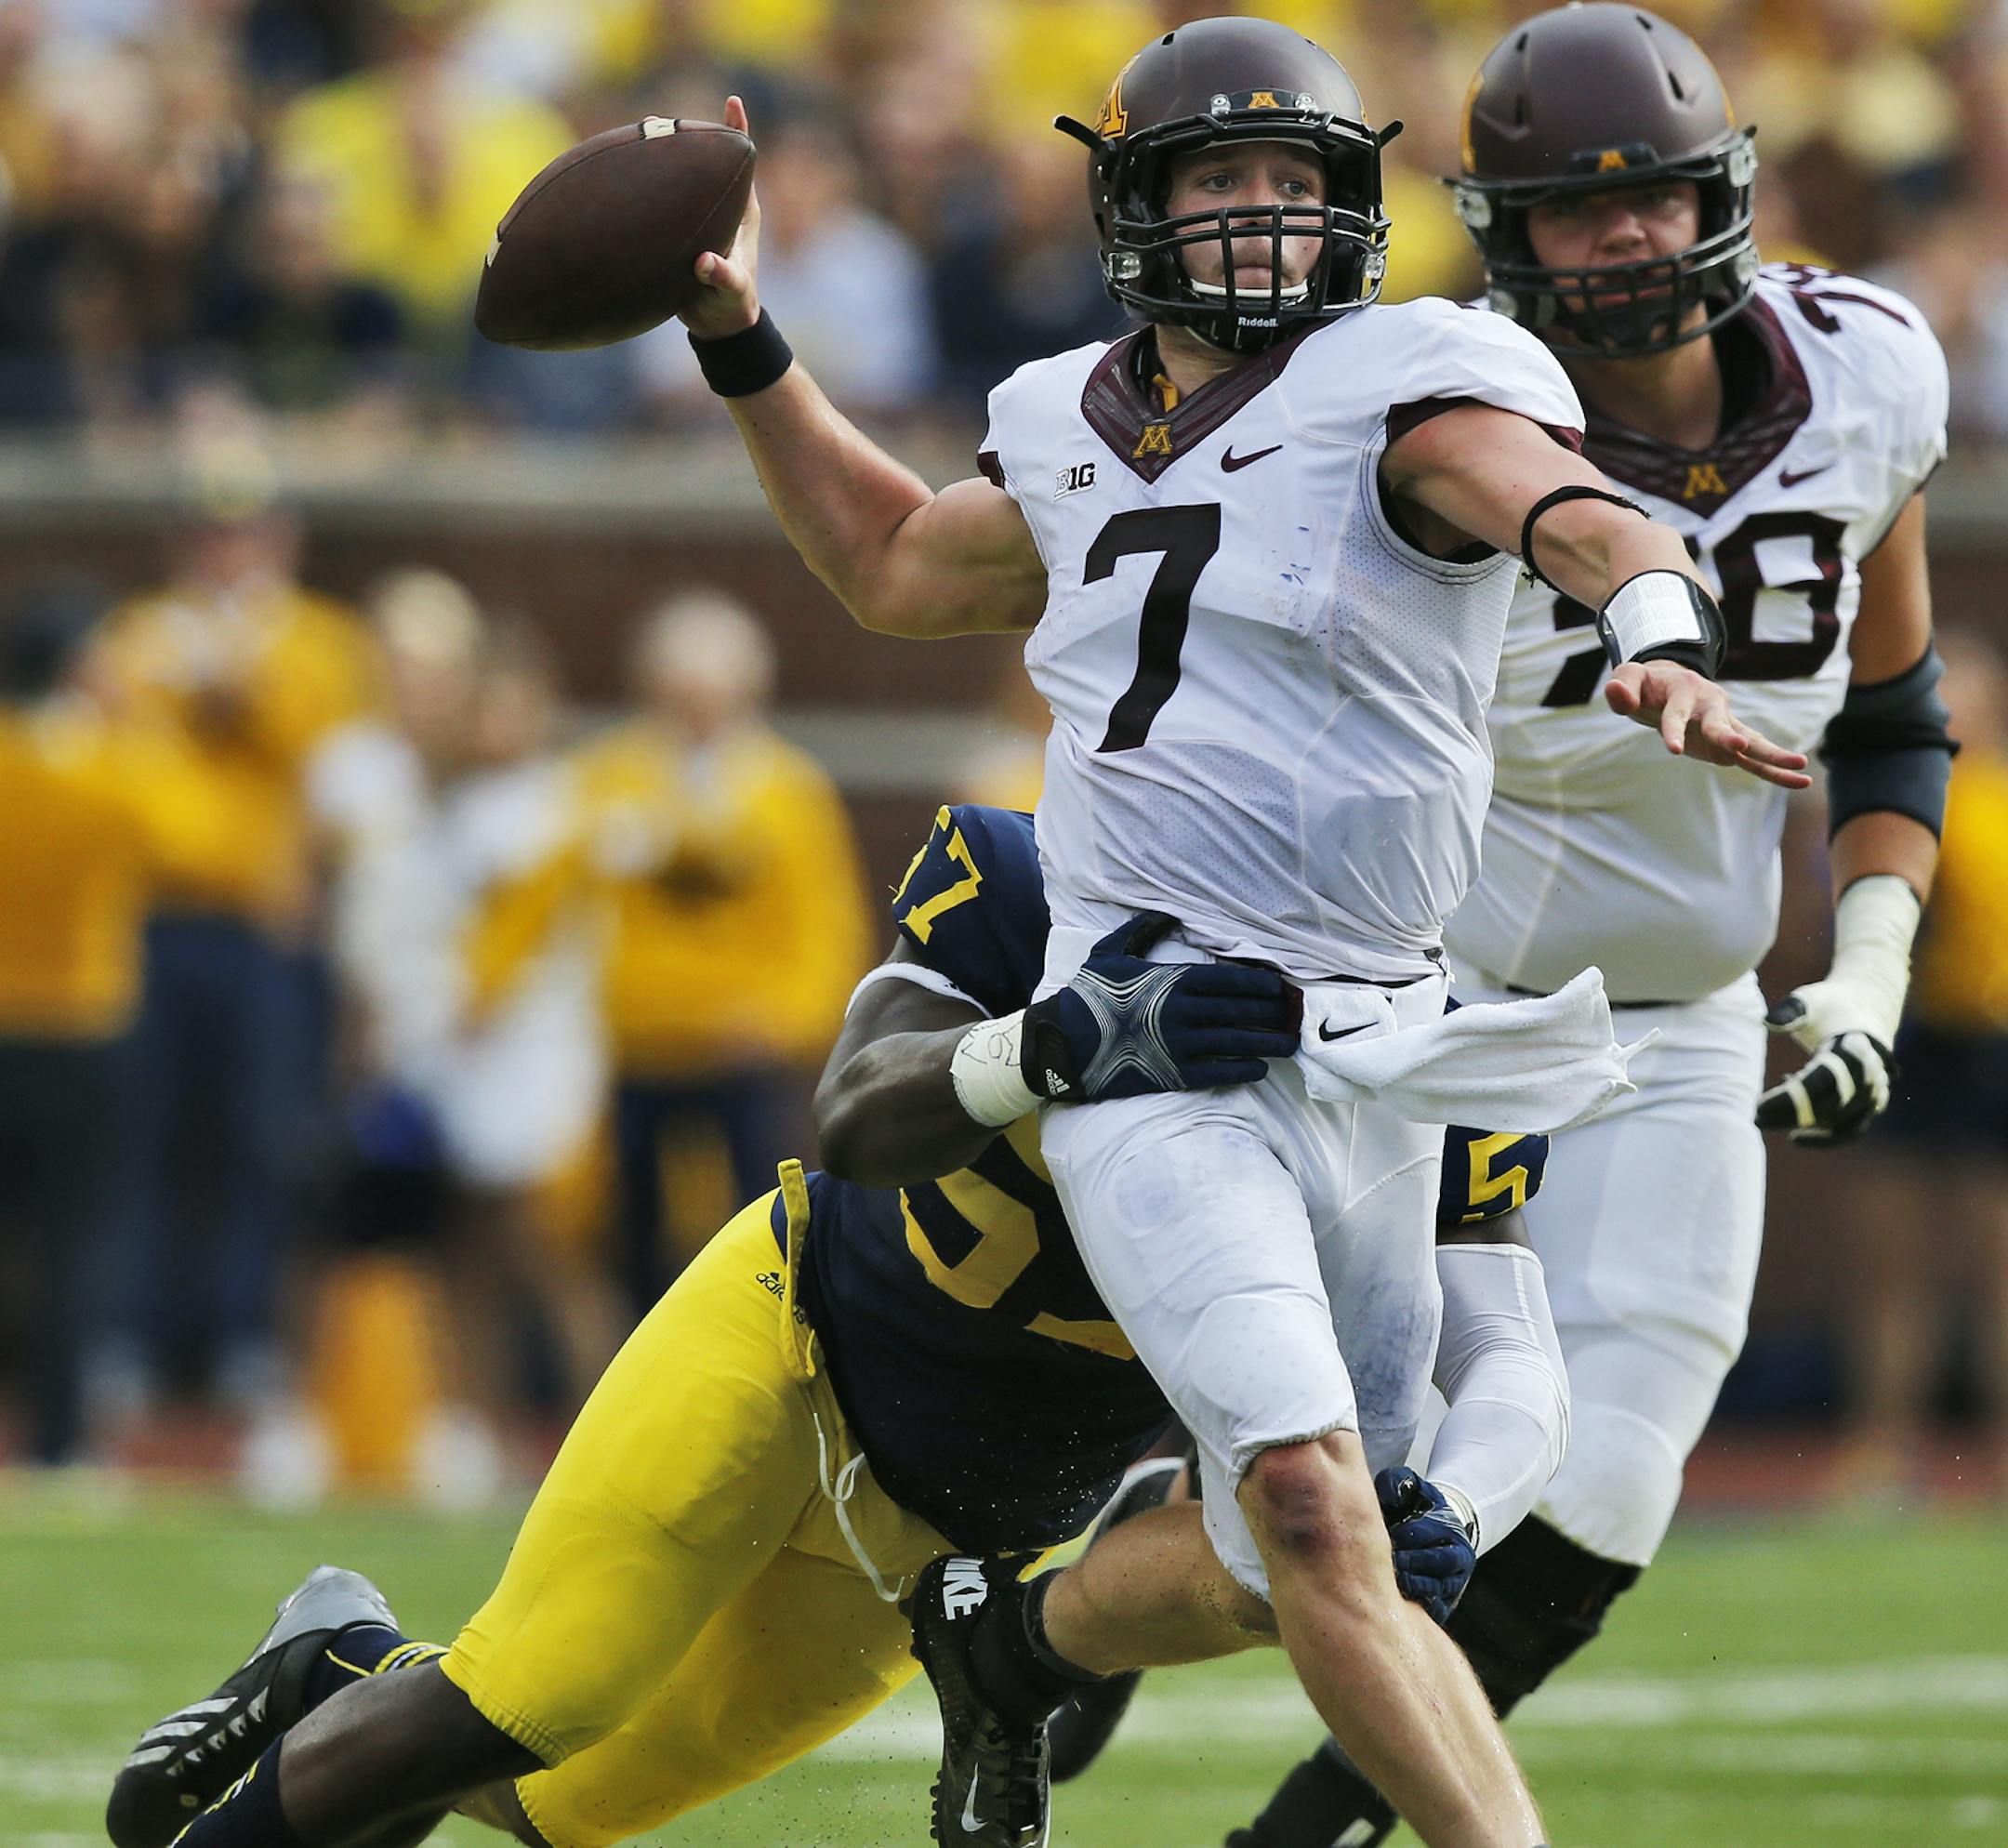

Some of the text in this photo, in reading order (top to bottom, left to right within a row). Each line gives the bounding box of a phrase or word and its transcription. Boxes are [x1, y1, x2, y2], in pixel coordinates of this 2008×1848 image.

[1248, 92, 1280, 110] M
[1131, 424, 1173, 458] M
[1082, 502, 1222, 752] 7
[755, 1273, 805, 1325] adis
